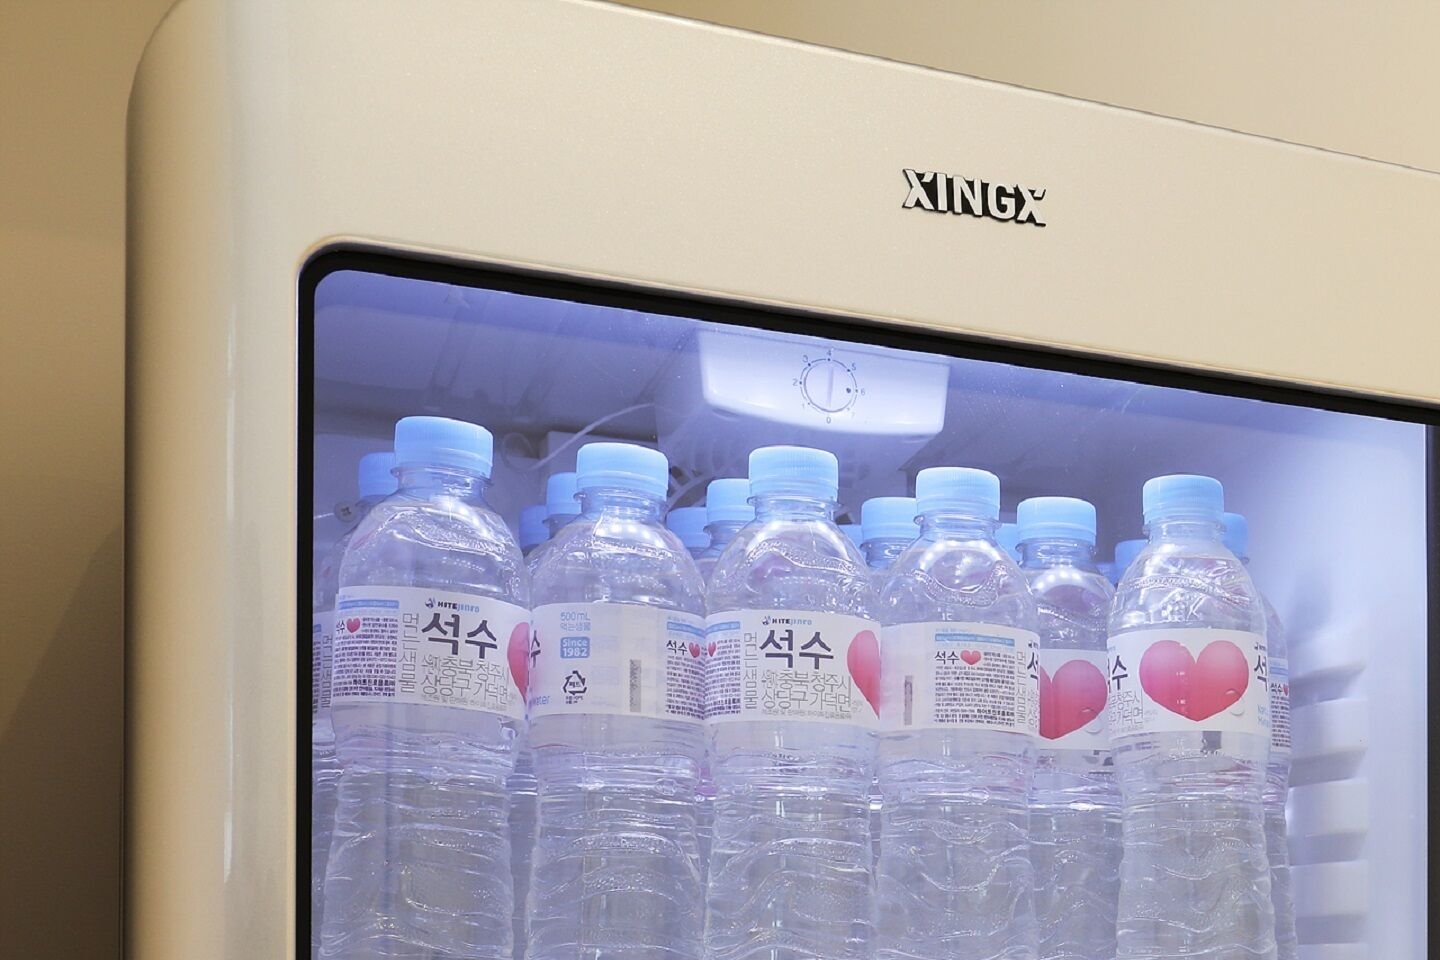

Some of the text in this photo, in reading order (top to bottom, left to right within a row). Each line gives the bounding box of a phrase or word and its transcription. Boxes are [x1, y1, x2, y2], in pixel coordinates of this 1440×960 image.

[902, 169, 1046, 227] XINGX
[421, 613, 498, 659] 석수
[562, 639, 588, 647] Since
[667, 640, 688, 655] 석수
[562, 648, 588, 657] 1982
[760, 630, 834, 670] 석수
[934, 651, 960, 665] 석수
[440, 656, 475, 679] 충북
[420, 675, 471, 697] 상당구
[778, 670, 810, 690] 충북
[810, 672, 852, 694] 청주시
[761, 689, 852, 713] 상당구 가덕면
